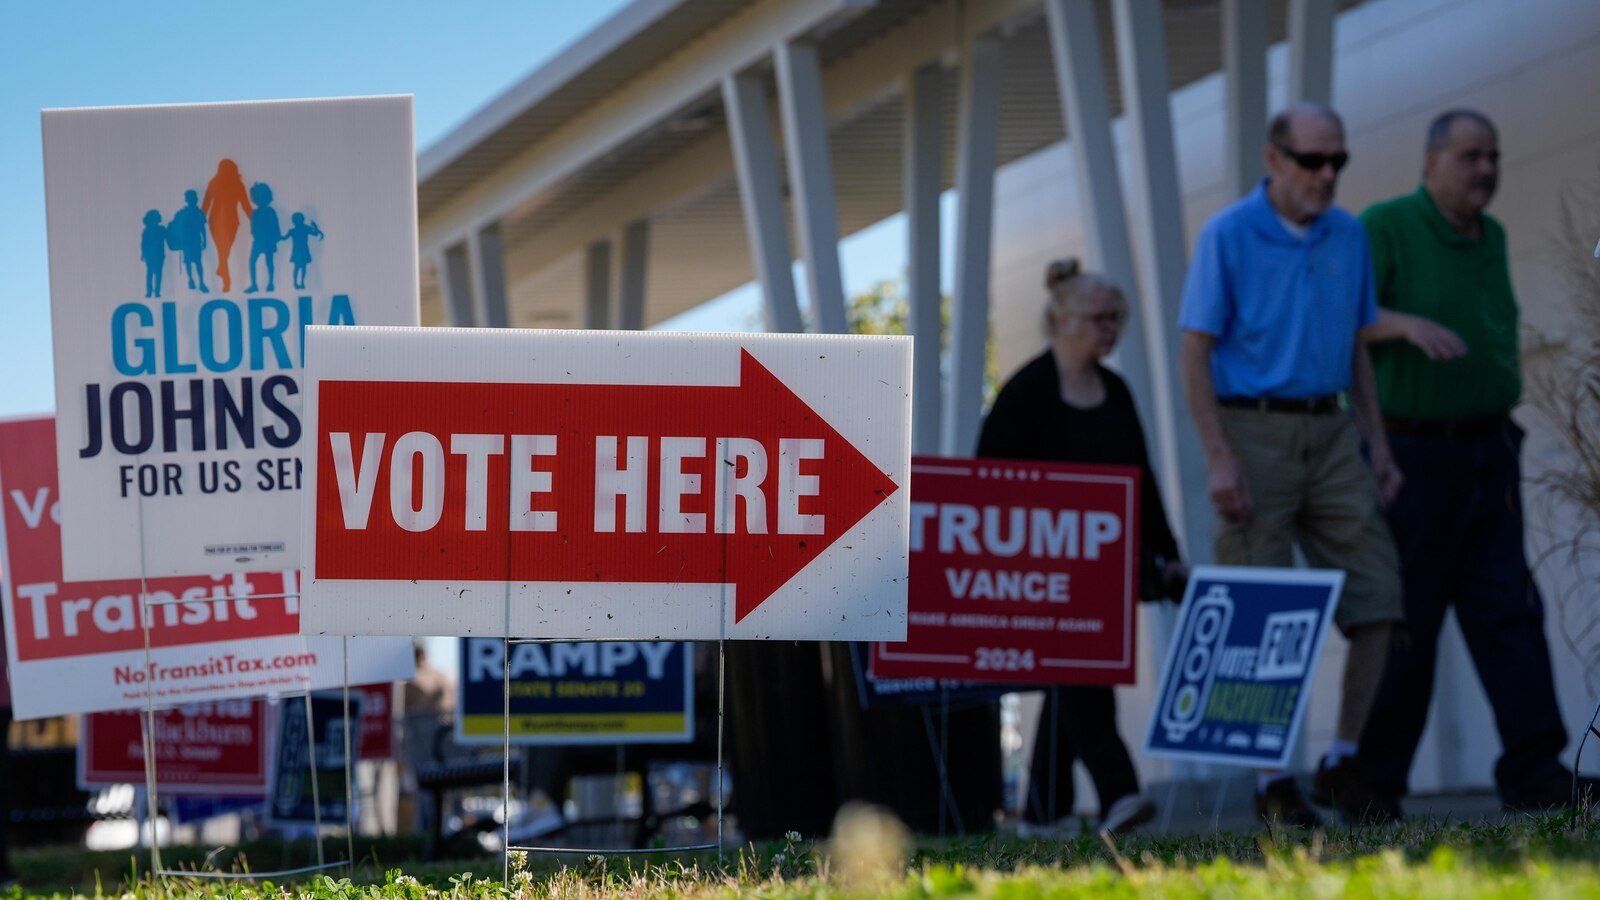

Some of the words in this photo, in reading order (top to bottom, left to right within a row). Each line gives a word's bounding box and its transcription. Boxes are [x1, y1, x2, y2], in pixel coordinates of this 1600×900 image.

[119, 463, 183, 498] FOR
[199, 460, 242, 494] US
[329, 431, 558, 533] VOTE
[593, 435, 826, 536] HERE
[909, 502, 1122, 560] TRUMP
[945, 568, 1070, 603] VANCE
[17, 572, 258, 640] Transit
[115, 653, 316, 685] NoTransitTax.com
[469, 638, 674, 682] RAMPY
[974, 648, 1035, 671] 2024
[149, 716, 252, 746] lackburn
